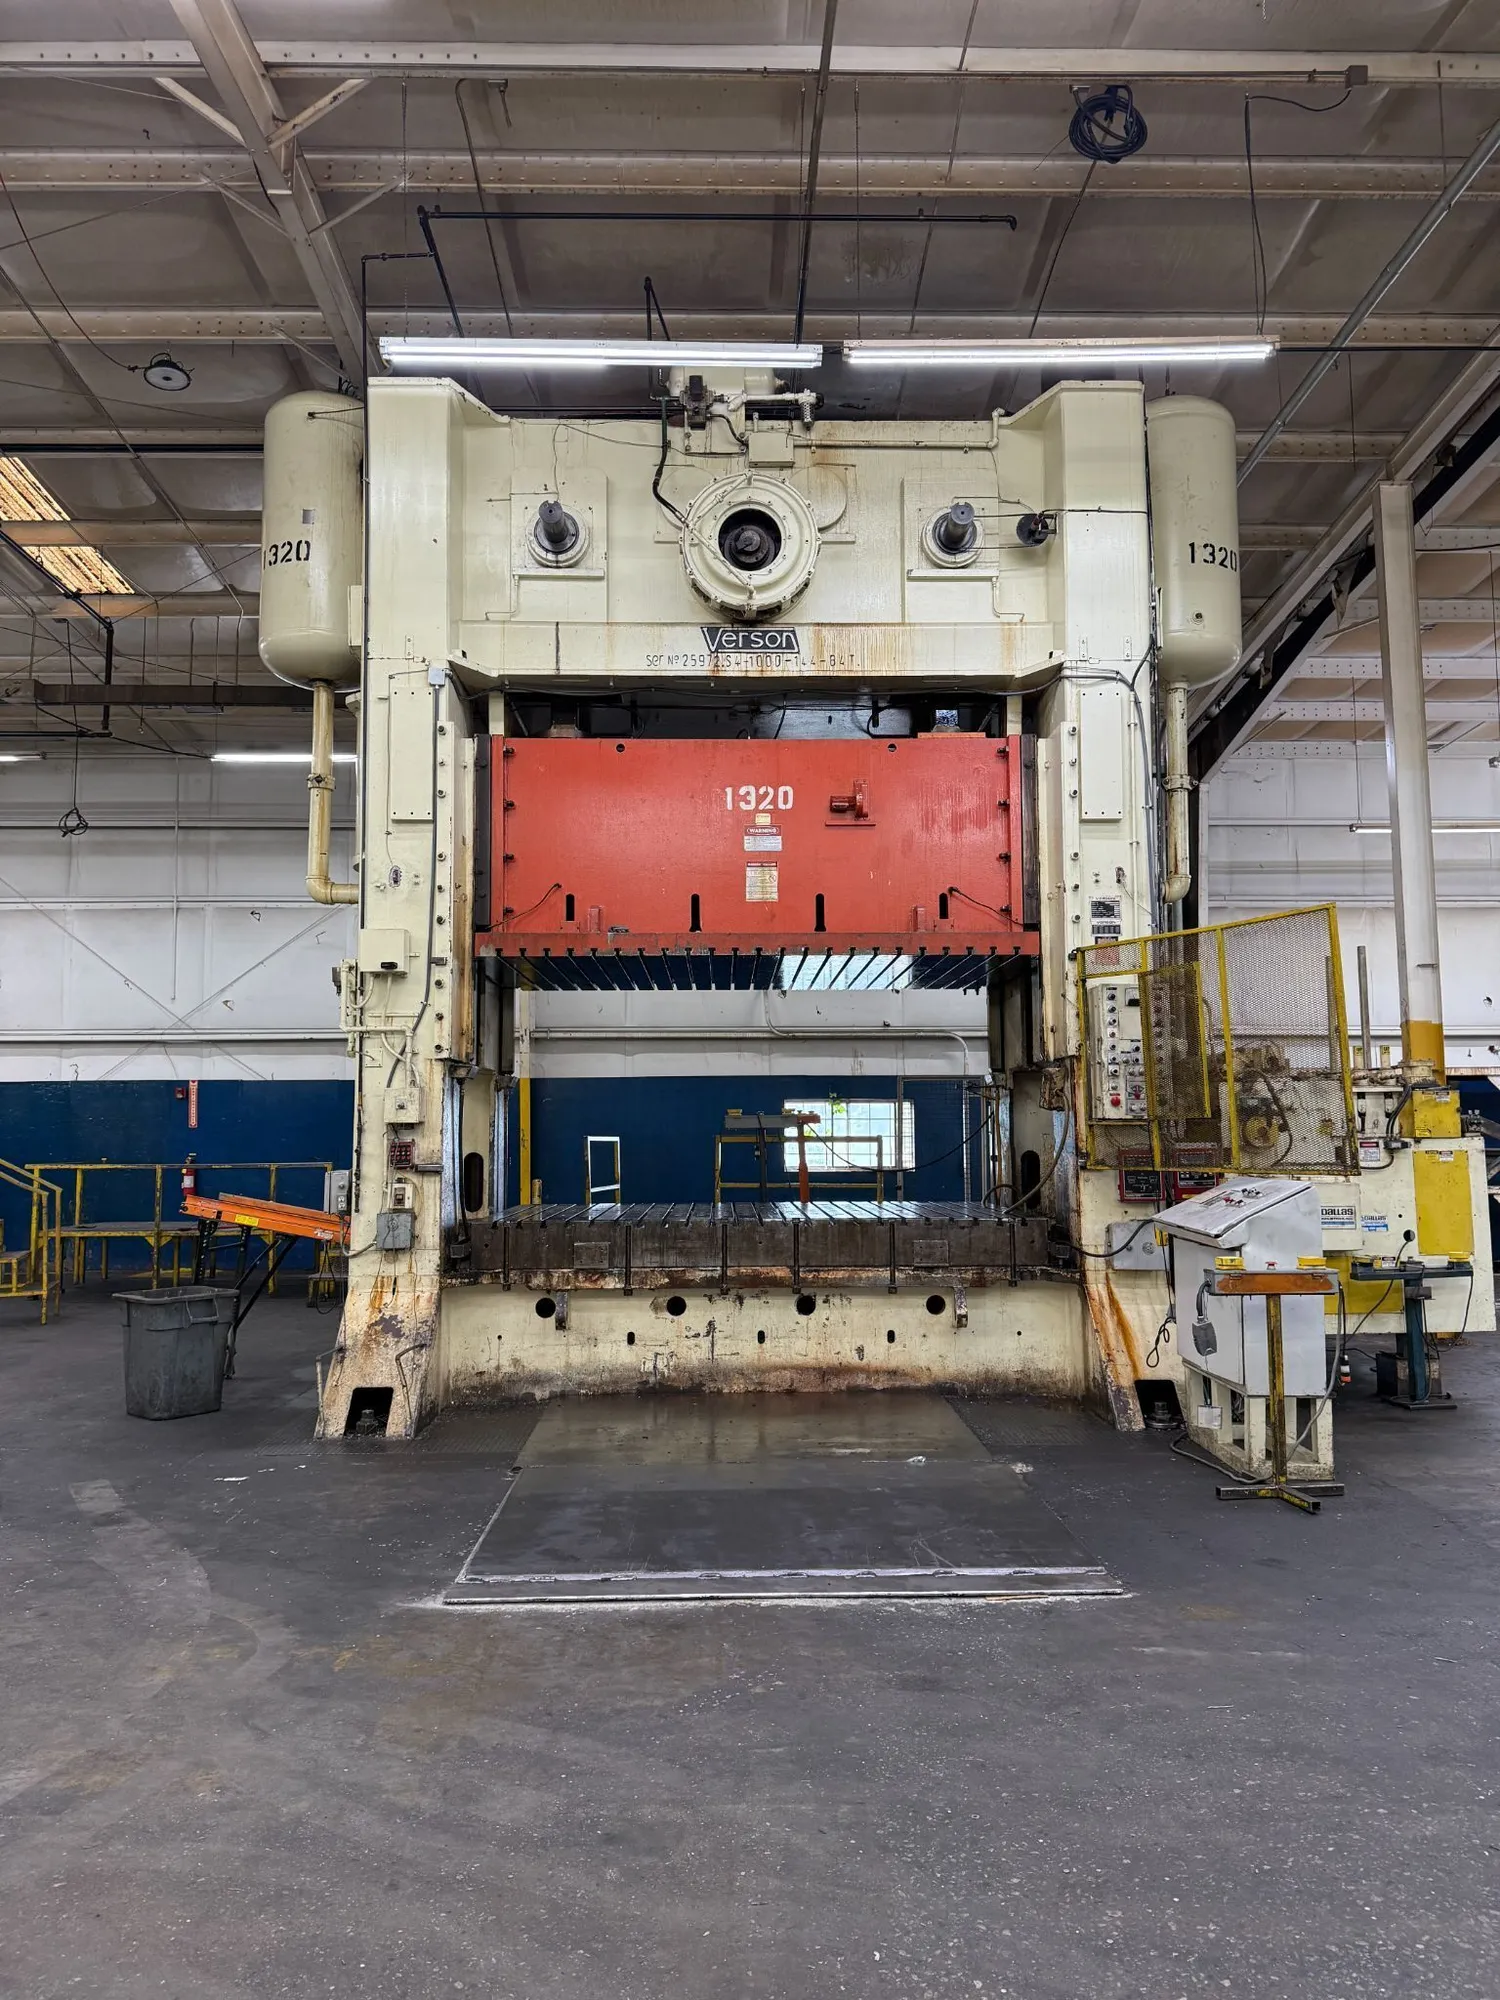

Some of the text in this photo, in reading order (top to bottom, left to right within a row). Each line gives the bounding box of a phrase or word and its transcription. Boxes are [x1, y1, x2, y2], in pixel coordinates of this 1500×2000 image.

[1189, 542, 1237, 572] 1320
[701, 627, 799, 652] Verson
[725, 785, 794, 810] 1320
